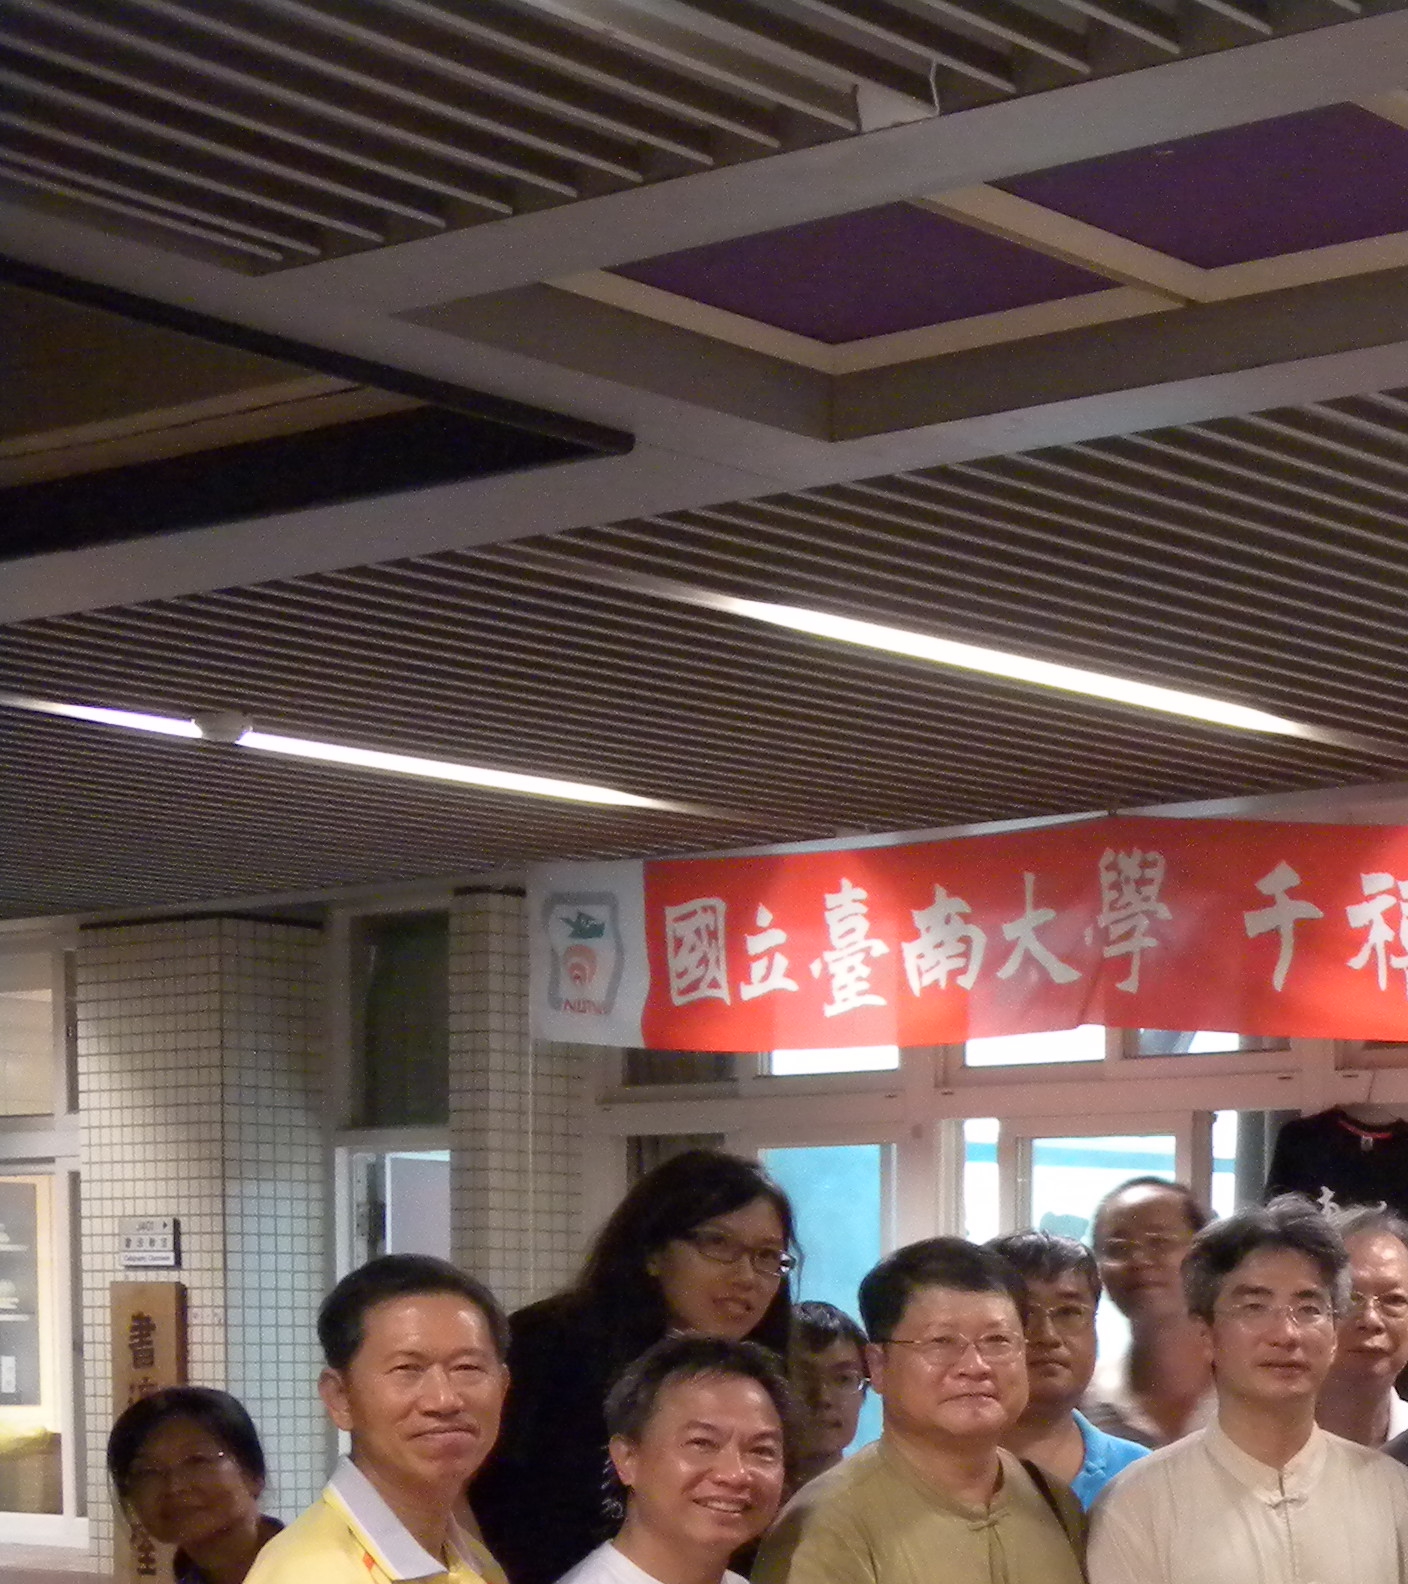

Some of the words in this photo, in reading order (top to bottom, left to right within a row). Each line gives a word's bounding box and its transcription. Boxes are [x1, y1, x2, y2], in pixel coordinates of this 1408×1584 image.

[663, 847, 1174, 1017] 國立臺南大學
